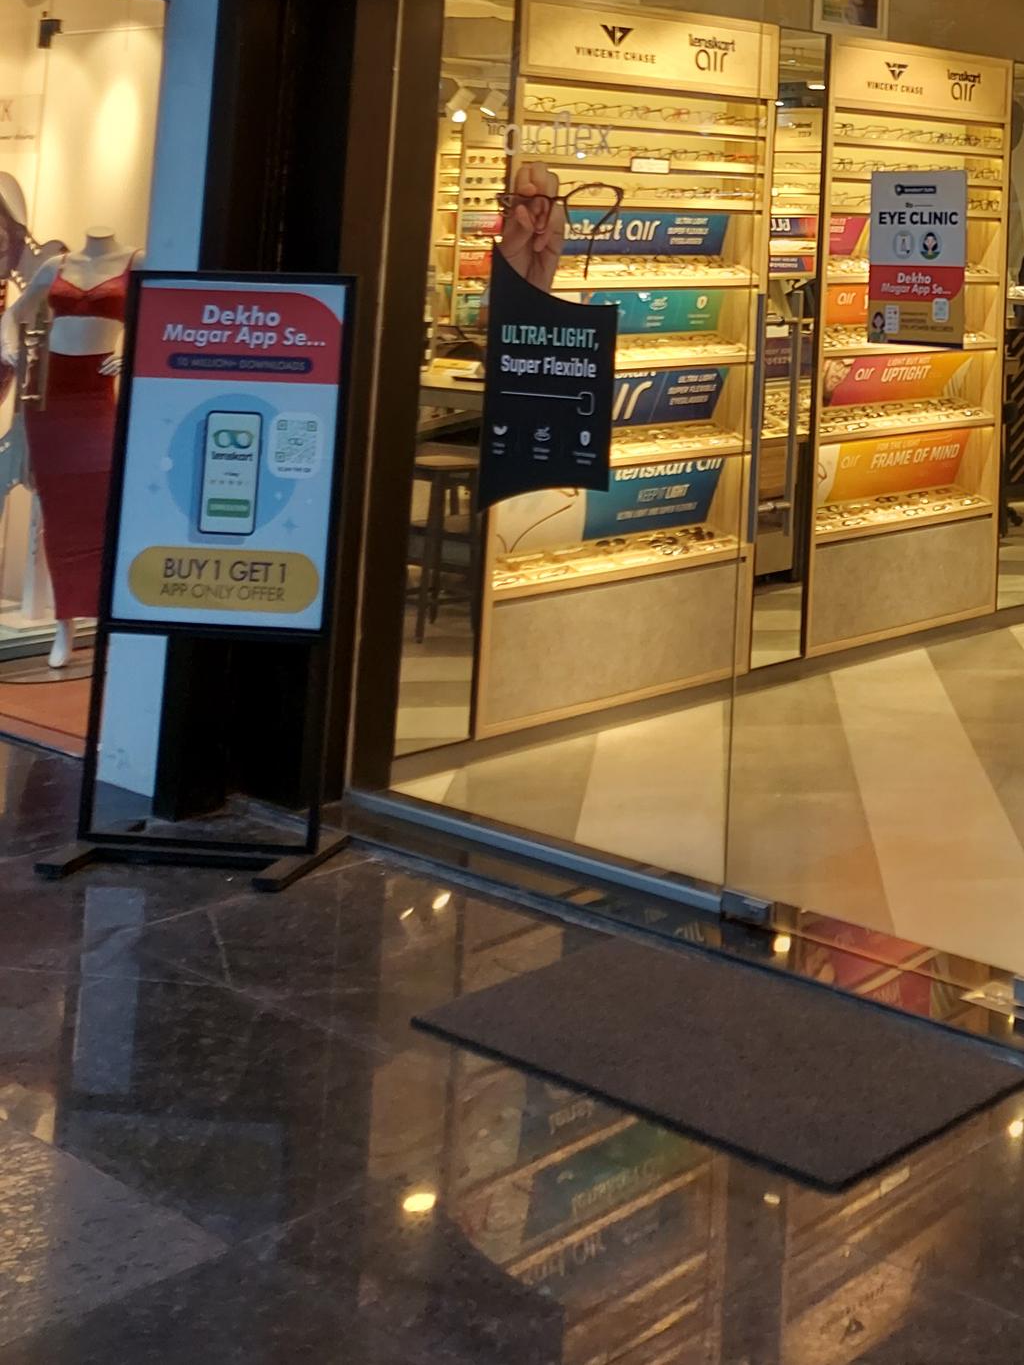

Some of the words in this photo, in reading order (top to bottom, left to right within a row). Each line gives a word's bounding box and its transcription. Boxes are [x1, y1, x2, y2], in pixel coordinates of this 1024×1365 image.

[688, 34, 736, 52] lenskart
[575, 45, 621, 61] VINCENT
[623, 51, 657, 64] CHASE
[695, 49, 728, 72] air
[866, 80, 899, 92] VINCENT
[900, 85, 924, 95] CHASE
[951, 82, 975, 102] air
[878, 211, 907, 225] EYE
[909, 211, 959, 226] CLINIC
[626, 220, 662, 241] air
[896, 273, 932, 285] Dekho
[837, 292, 856, 305] air
[911, 283, 930, 296] App
[202, 305, 281, 327] Dekho
[162, 324, 232, 347] Magar
[234, 326, 278, 349] App
[501, 324, 599, 351] ULTRA-LIGHT,
[500, 354, 542, 376] Super
[543, 356, 597, 378] Flexible
[854, 367, 876, 381] air
[880, 365, 932, 383] UPTIGHT
[869, 449, 913, 470] FRAME
[912, 447, 930, 464] OF
[929, 443, 960, 462] MIND
[163, 558, 209, 579] BUY
[214, 559, 222, 580] 1
[229, 560, 274, 583] GET
[279, 563, 288, 584] 1
[160, 583, 189, 597] APP
[190, 584, 235, 601] ONLY
[236, 585, 285, 602] OFFER
